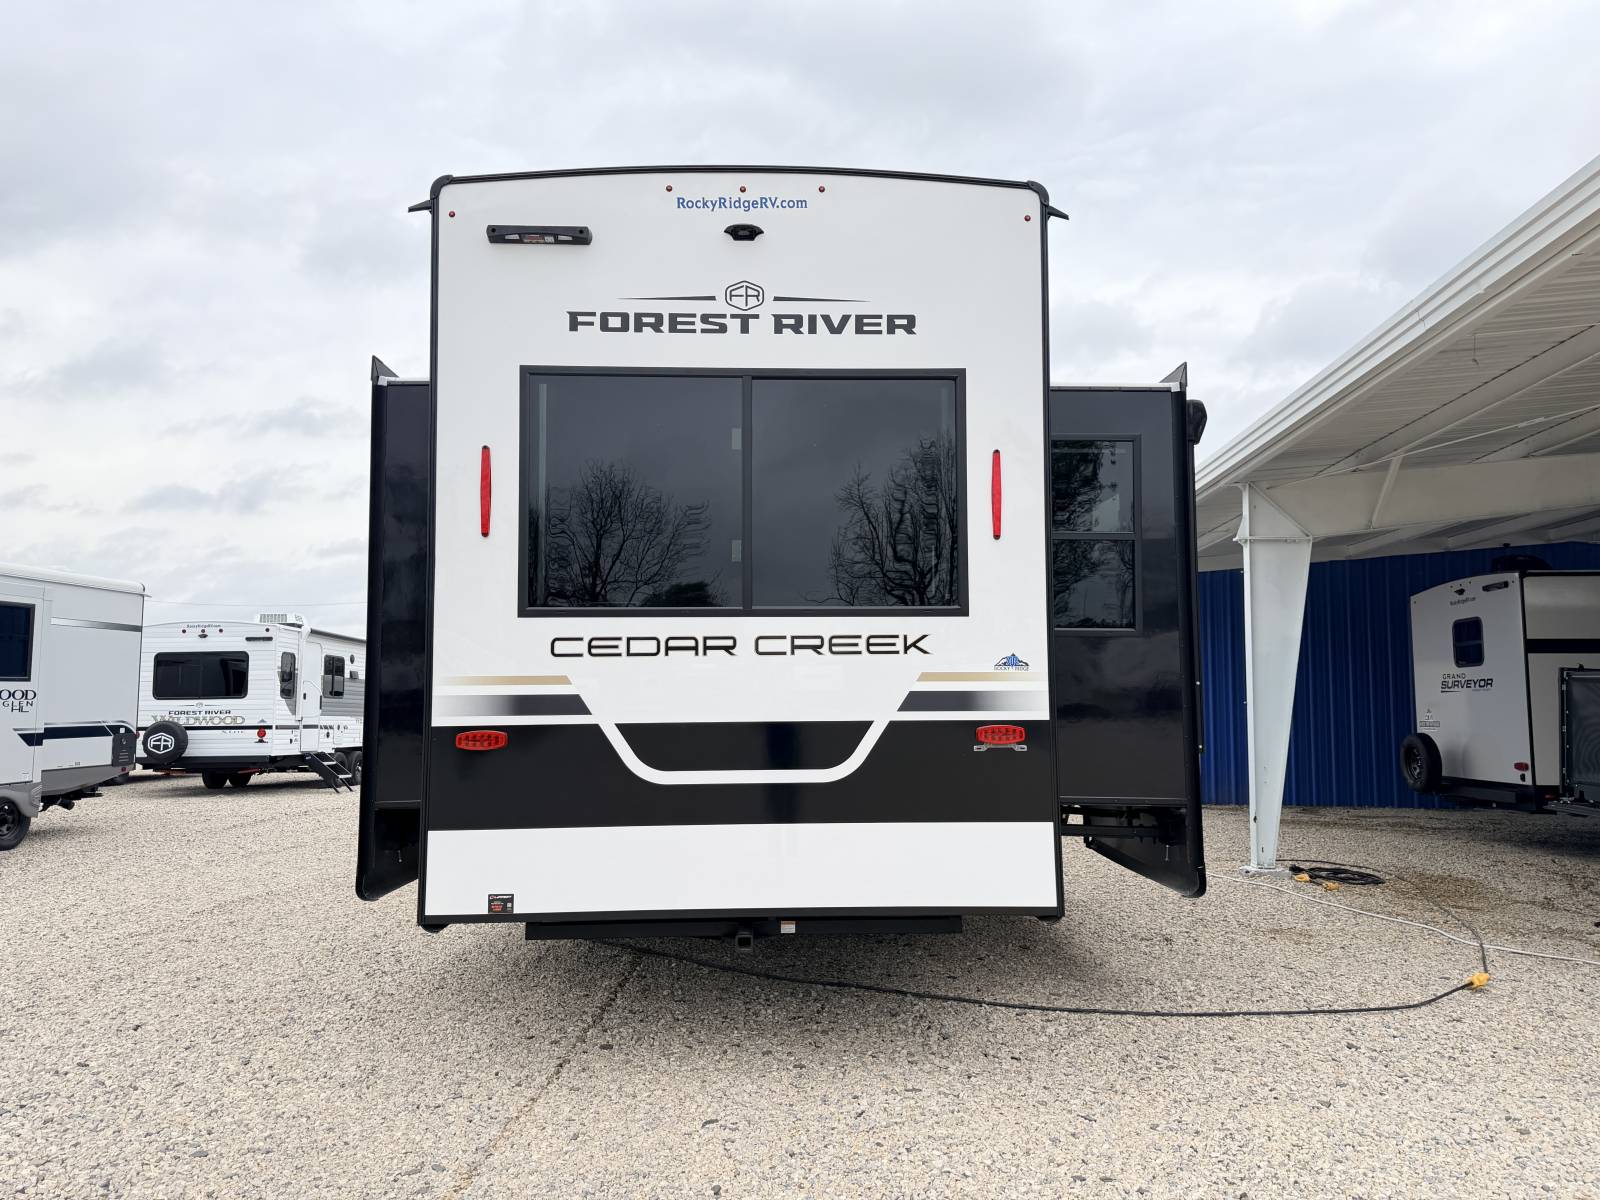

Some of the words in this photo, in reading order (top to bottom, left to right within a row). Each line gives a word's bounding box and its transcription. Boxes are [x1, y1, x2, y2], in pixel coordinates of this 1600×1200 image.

[677, 197, 808, 212] RockyRidgeRV.com
[728, 283, 762, 308] FR
[566, 311, 760, 334] FOREST
[771, 313, 917, 335] RIVER
[550, 636, 738, 657] CEDAR
[754, 634, 934, 656] CREEK
[1441, 678, 1494, 690] SURVEYOR
[2, 700, 33, 708] GLEN
[149, 734, 173, 752] FR
